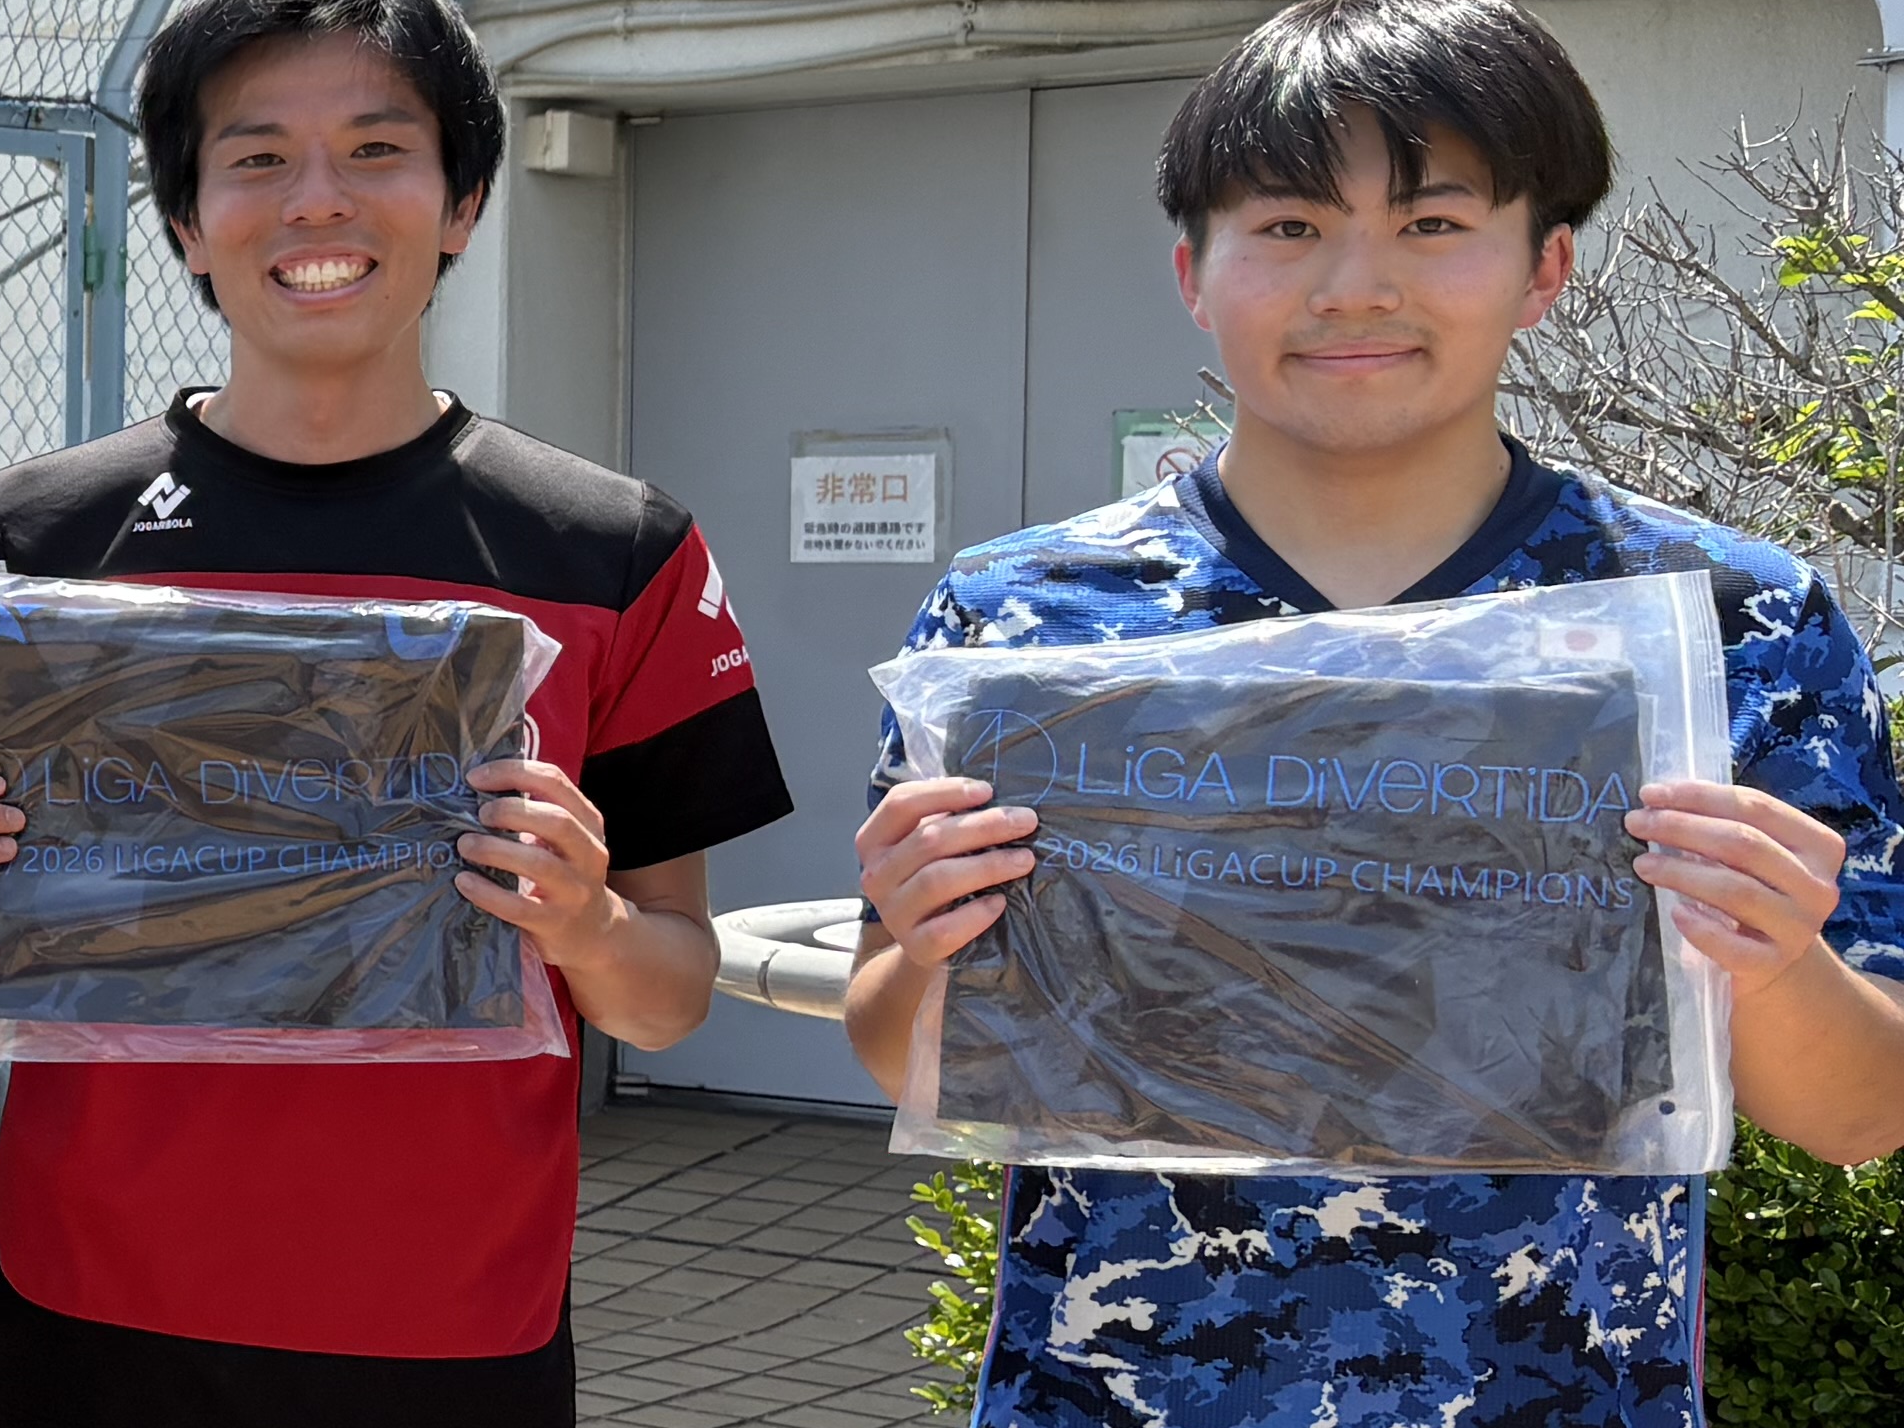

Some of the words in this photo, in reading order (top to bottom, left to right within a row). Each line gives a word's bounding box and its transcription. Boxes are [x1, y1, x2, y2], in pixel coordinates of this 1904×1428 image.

[816, 472, 909, 504] 非常口
[278, 841, 454, 870] CHAMPIO
[1351, 861, 1634, 911] CHAMPIONS
